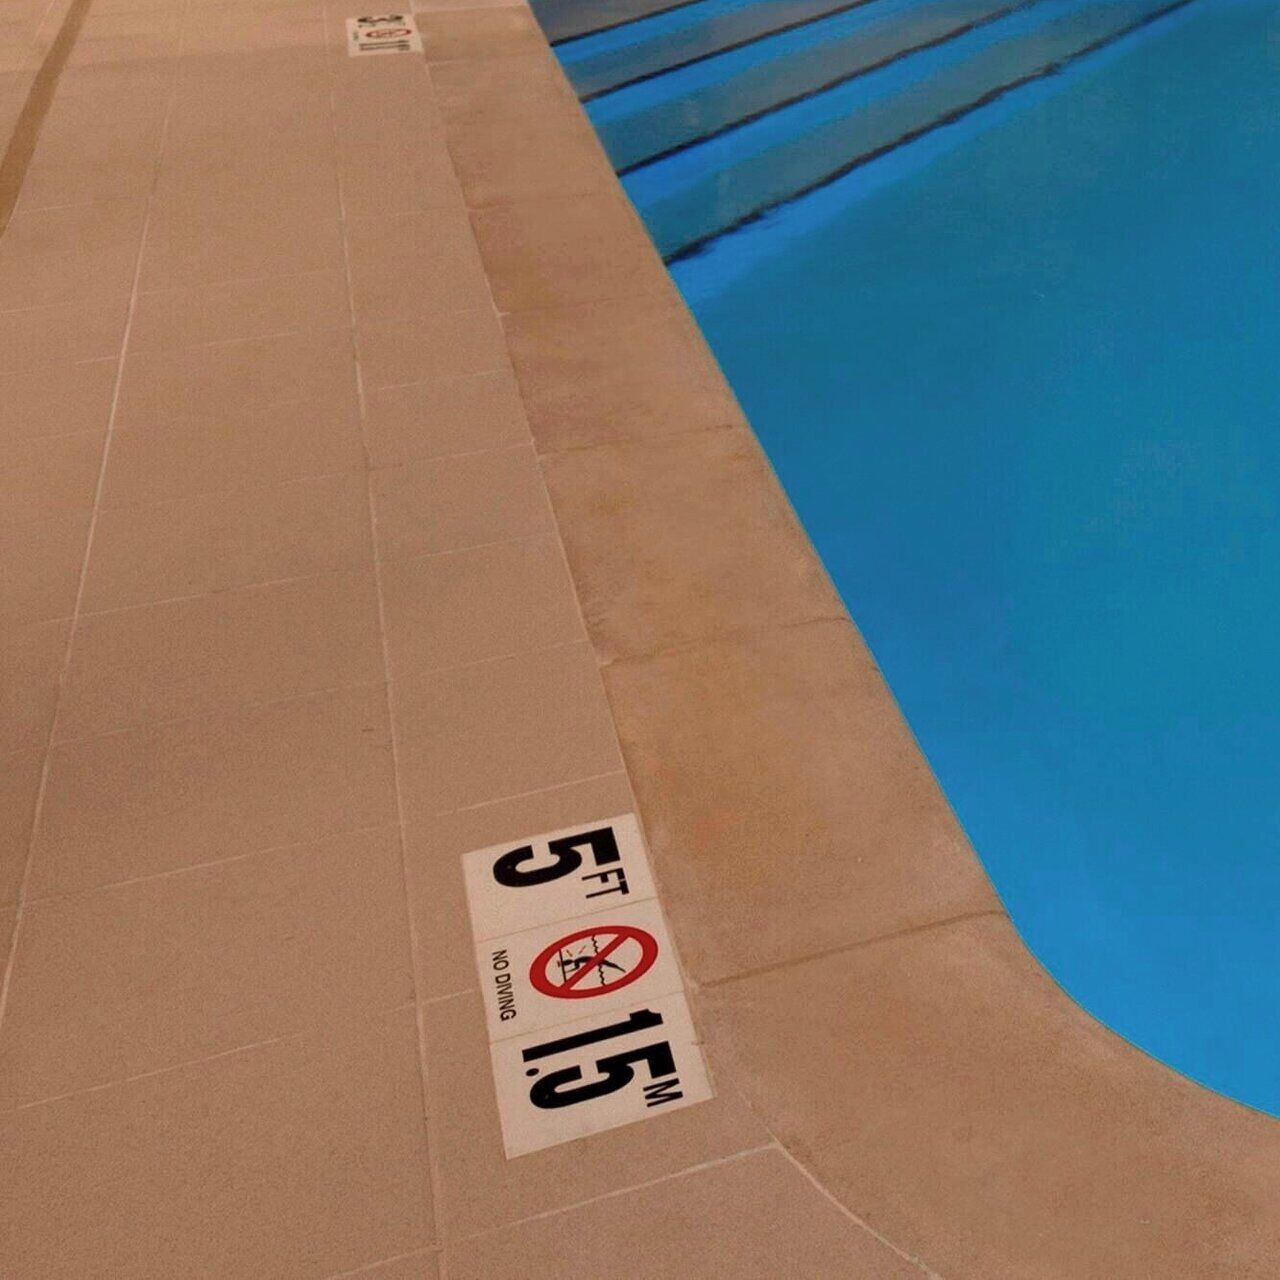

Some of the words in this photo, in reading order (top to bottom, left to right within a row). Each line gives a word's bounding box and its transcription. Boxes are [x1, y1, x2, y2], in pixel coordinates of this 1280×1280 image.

[493, 826, 621, 888] 5
[581, 867, 629, 899] FT
[492, 949, 509, 971] NO
[495, 972, 517, 1022] DIVING
[643, 1077, 683, 1108] M
